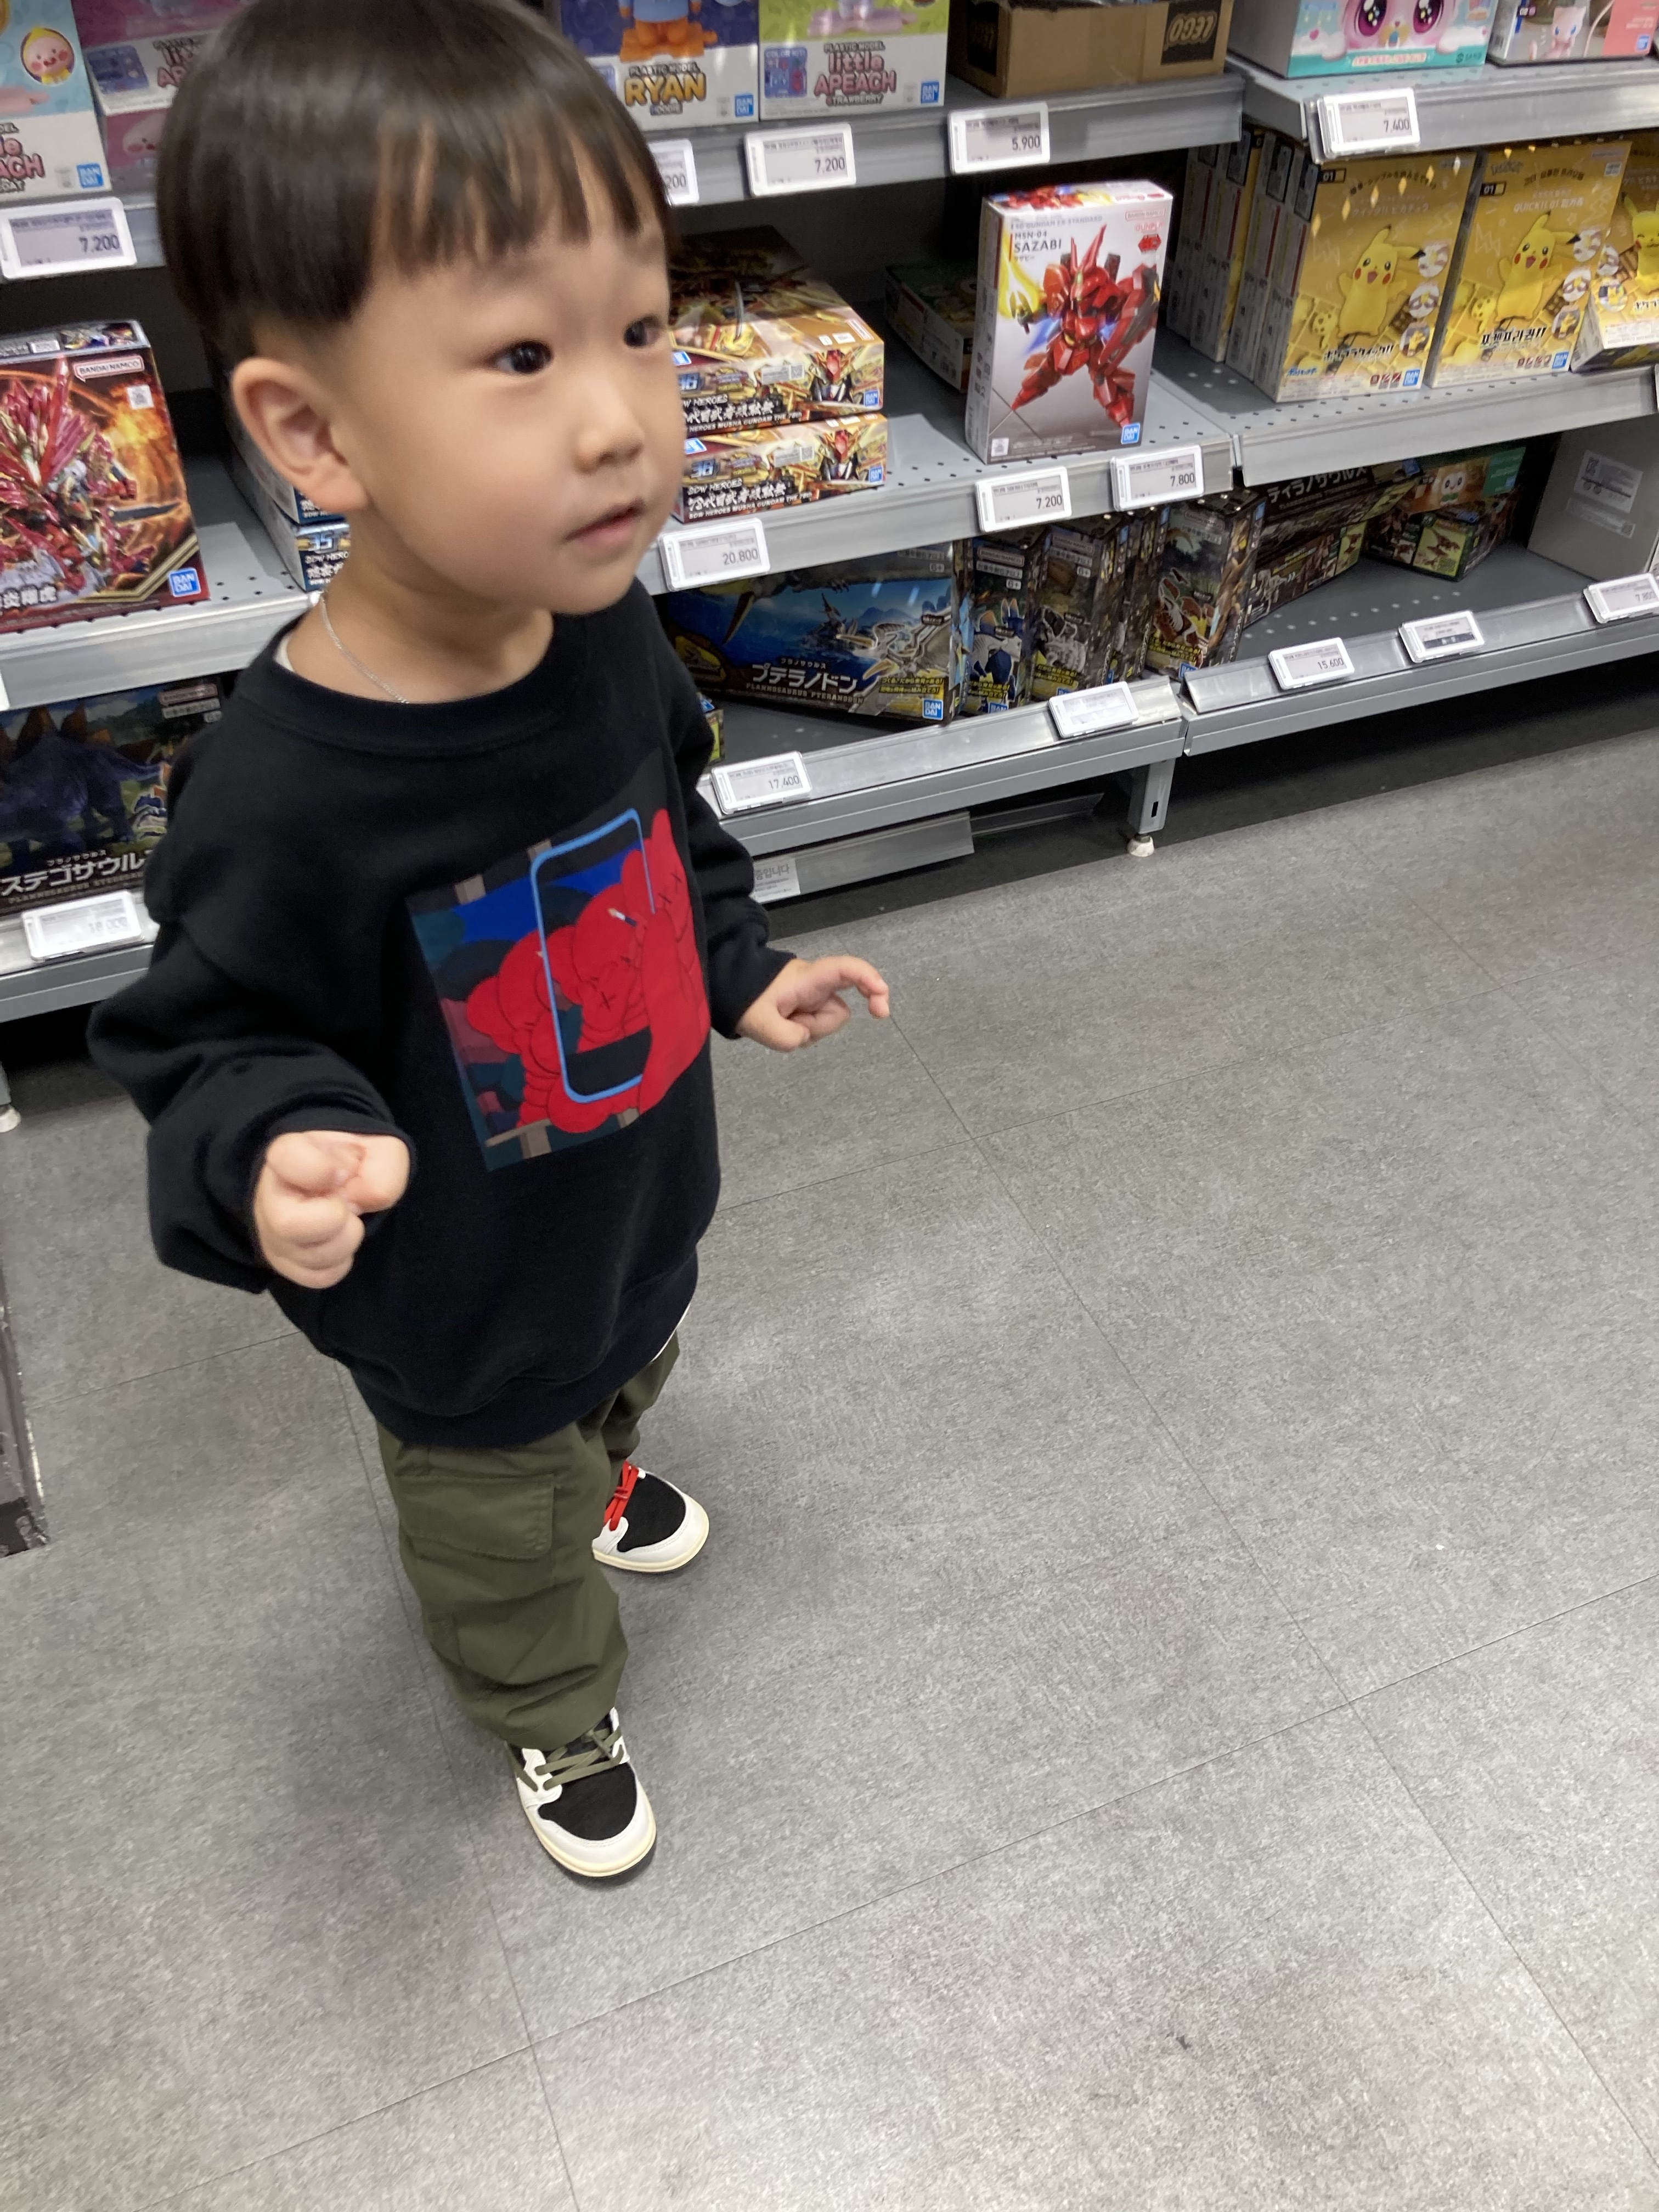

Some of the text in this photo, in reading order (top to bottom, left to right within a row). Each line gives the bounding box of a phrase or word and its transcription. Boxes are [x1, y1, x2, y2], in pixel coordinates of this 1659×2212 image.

[828, 51, 884, 74] little
[624, 72, 707, 106] RYAN
[814, 70, 896, 97] APEACH
[1384, 119, 1410, 133] 7,400
[1012, 136, 1040, 151] 5,900
[815, 157, 845, 173] 7,200
[1015, 230, 1047, 239] MSN-04
[78, 234, 120, 252] 7,200
[1014, 239, 1062, 253] SAZABI
[80, 360, 140, 374] BANDAI NAMCO
[693, 393, 728, 407] HEROES
[688, 477, 742, 496] SDW HEROES
[1170, 473, 1195, 487] 7,800
[689, 512, 704, 520] SDW
[706, 507, 731, 517] HEROES
[757, 497, 785, 508] GUNDAM
[1036, 494, 1062, 509] 7,200
[723, 548, 758, 566] 20,800
[172, 574, 195, 584] BAN
[174, 583, 193, 593] DAI
[1317, 658, 1344, 670] 15,600
[752, 662, 859, 695] プテラノドン
[925, 702, 941, 710] BAN
[925, 708, 938, 716] DAI
[769, 775, 800, 790] 17,400
[1, 850, 153, 896] ステゴサウル
